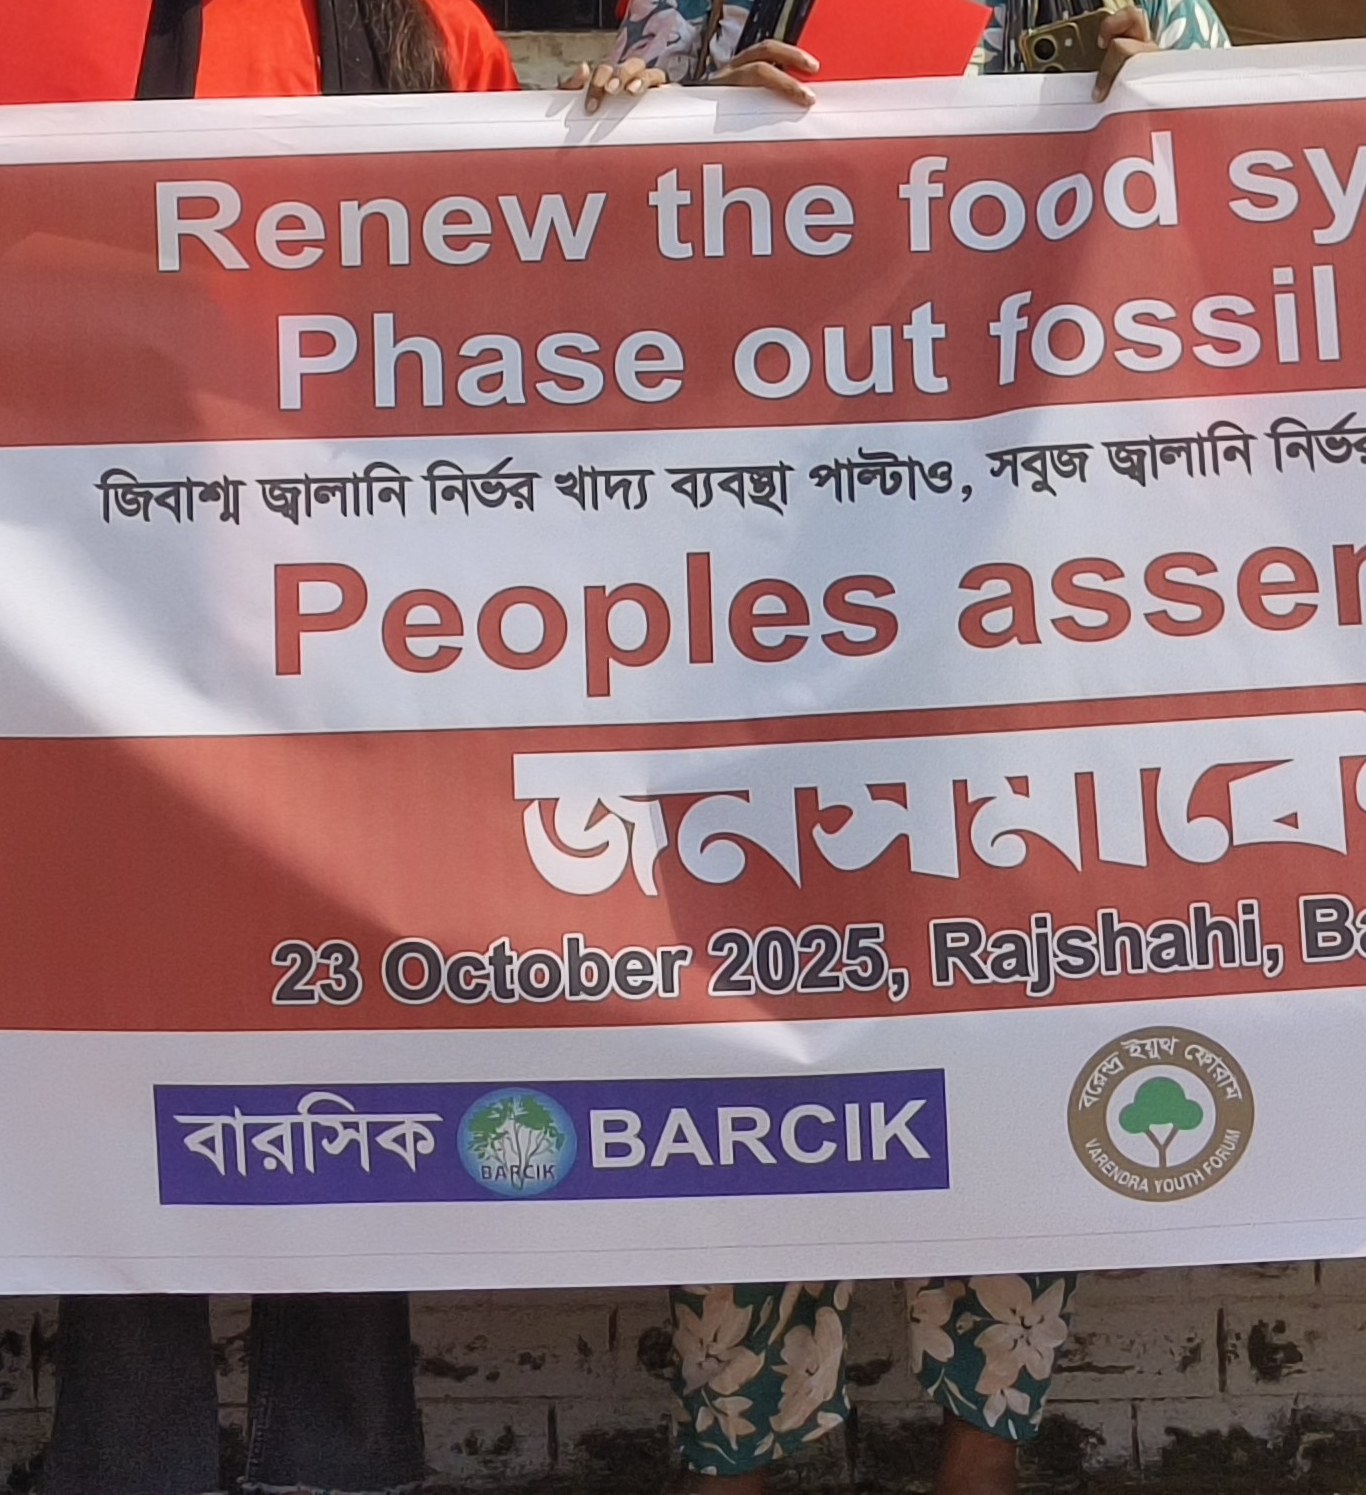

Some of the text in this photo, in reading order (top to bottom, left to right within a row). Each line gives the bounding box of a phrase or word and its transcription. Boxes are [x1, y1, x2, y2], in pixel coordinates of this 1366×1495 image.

[153, 178, 609, 274] Renew
[648, 162, 856, 260] the
[898, 130, 1180, 254] food
[276, 311, 686, 411] Phase
[731, 300, 951, 402] out
[988, 261, 1342, 387] fossil
[94, 468, 247, 525] জিবাশ্ম
[255, 461, 413, 525] জ্বালানি
[420, 456, 542, 516] নির্ভর
[554, 464, 655, 511] খাদ্য
[664, 460, 795, 516] ব্যবস্থা
[808, 446, 972, 504] পাল্টাও,
[986, 442, 1093, 497] সবুজ
[1101, 419, 1258, 487] জ্বালানি
[273, 551, 900, 698] Peoples
[271, 938, 362, 1005] 23
[382, 932, 691, 1005] October
[707, 922, 910, 1002] 2025,
[929, 900, 1285, 997] Rajshahi,
[174, 1091, 442, 1177] বারসিক
[481, 1164, 556, 1180] BARCIK
[588, 1099, 931, 1169] BARCIK
[1086, 1129, 1241, 1194] VARENDRA YOUTH FORUM
